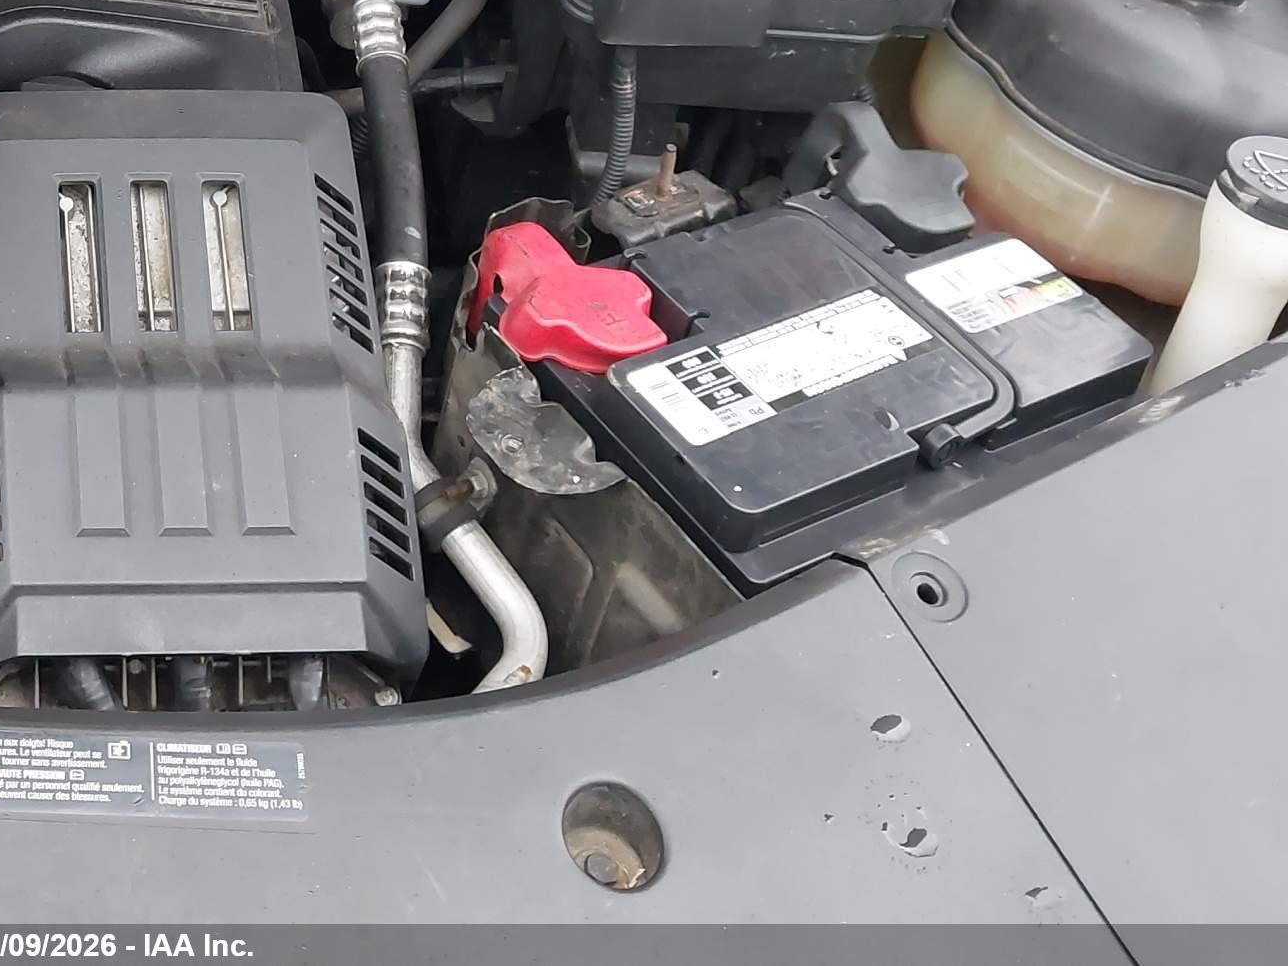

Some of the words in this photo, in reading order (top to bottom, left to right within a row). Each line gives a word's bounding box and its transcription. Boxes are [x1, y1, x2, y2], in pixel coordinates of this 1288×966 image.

[3, 738, 18, 746] aux
[19, 738, 46, 749] doigts!
[47, 739, 74, 749] Risque
[20, 748, 30, 756] Le
[31, 748, 72, 758] ventilateur
[73, 750, 91, 759] peut
[92, 751, 102, 759] se
[1, 757, 31, 766] tourner
[51, 759, 108, 769] avertissement.
[157, 755, 185, 764] Utiliser
[185, 756, 226, 766] seulement
[226, 757, 235, 766] le
[235, 758, 258, 767] fluide
[157, 766, 200, 776] frigorigène
[200, 766, 230, 776] R-134a
[231, 768, 240, 777] et
[240, 769, 251, 777] de
[5, 781, 19, 790] par
[20, 781, 31, 789] un
[32, 781, 71, 791] personnel
[72, 782, 101, 792] qualifié
[101, 784, 145, 793] seulement.
[240, 778, 263, 787] (huile
[263, 778, 284, 789] PAG).
[27, 792, 55, 800] causer
[55, 791, 70, 801] des
[71, 792, 112, 802] blessures.
[158, 786, 169, 794] Le
[169, 786, 203, 796] système
[203, 787, 236, 796] contient
[236, 788, 248, 797] du
[248, 788, 283, 798] colorant.
[158, 796, 187, 807] Charge
[188, 797, 199, 806] du
[199, 798, 233, 808] système
[258, 799, 269, 809] kg
[292, 800, 303, 811] lb)
